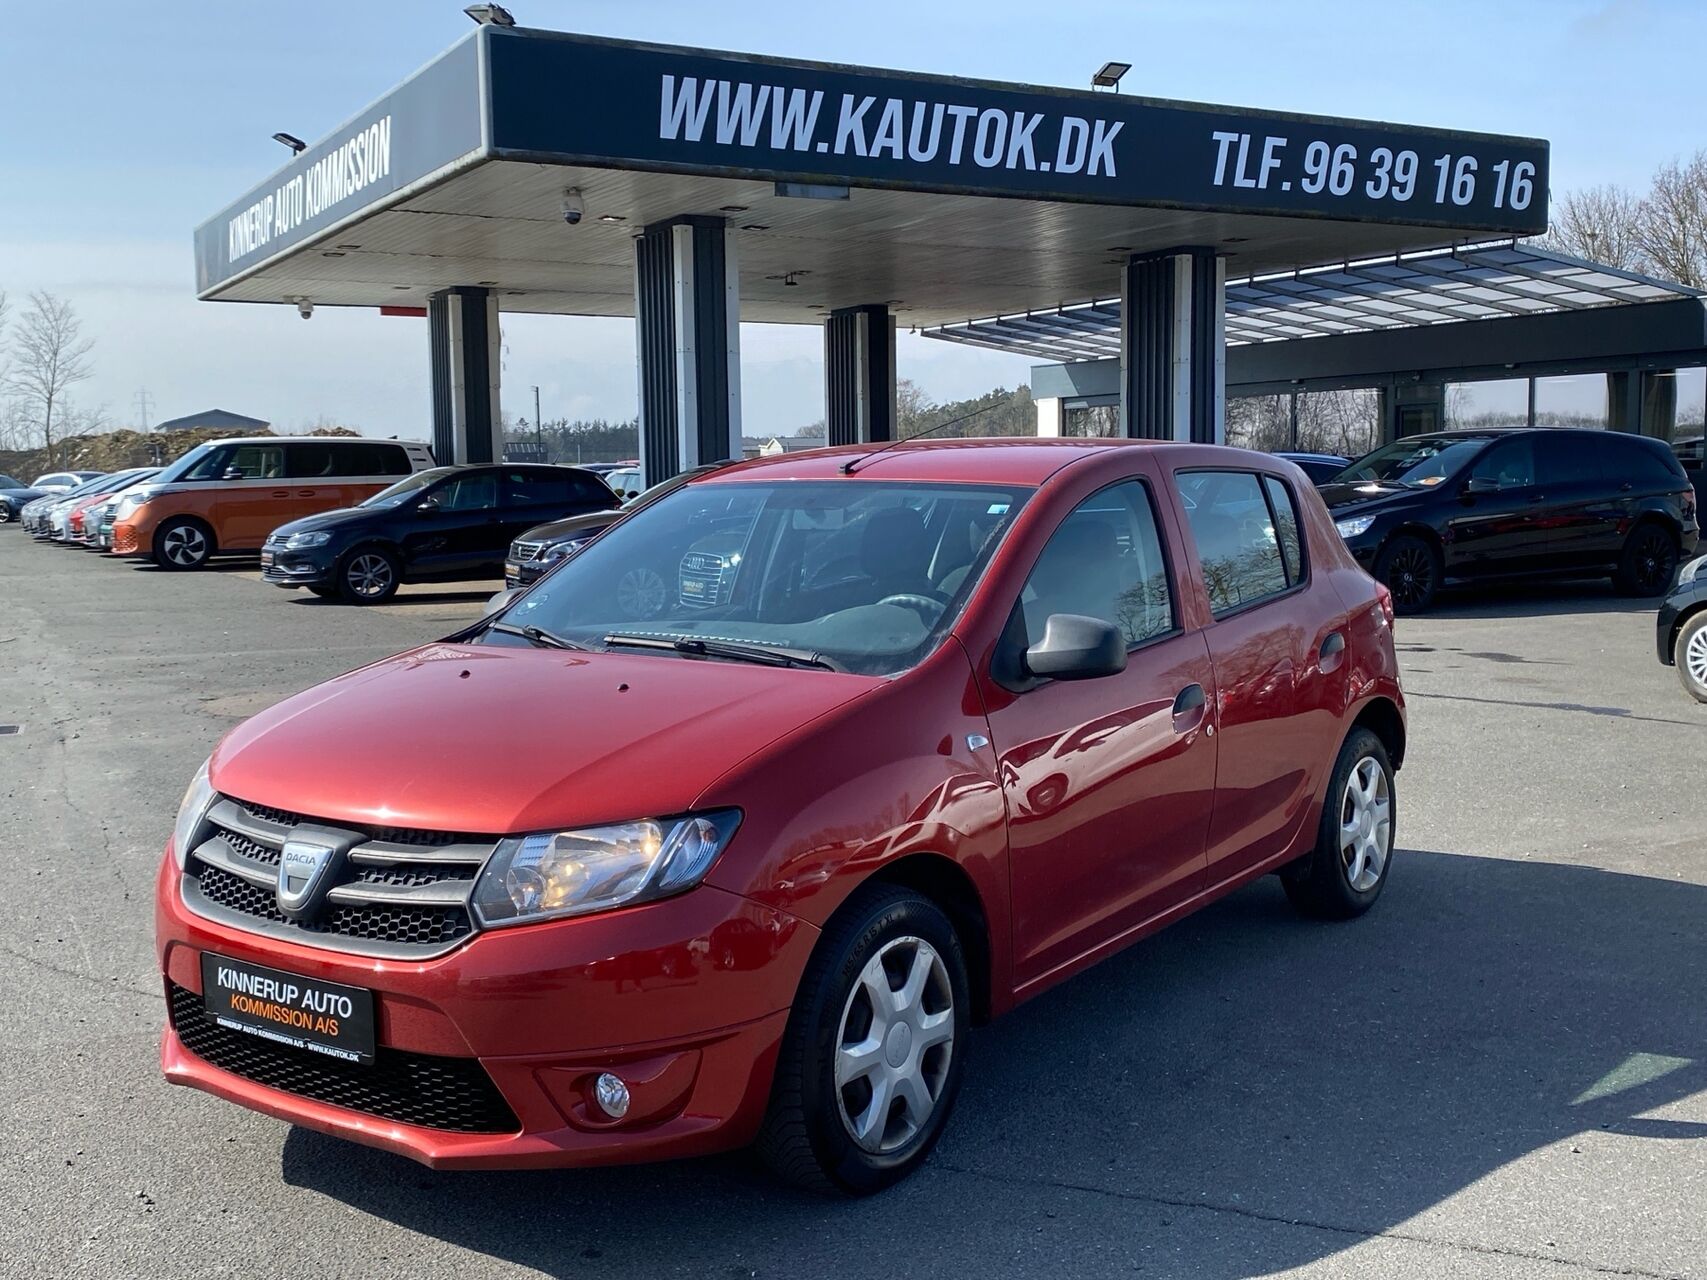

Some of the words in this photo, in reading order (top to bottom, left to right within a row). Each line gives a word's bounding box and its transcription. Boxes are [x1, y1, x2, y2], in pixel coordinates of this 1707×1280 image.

[659, 74, 1126, 178] WWW.KAUTOK.DK
[229, 194, 274, 264] KINNERUP
[274, 174, 303, 238] AUTO
[305, 114, 392, 221] KOMMISSION
[1212, 130, 1292, 192] TLF.
[1301, 140, 1358, 197] 96
[1365, 147, 1419, 202] 39
[1433, 154, 1479, 207] 16
[1492, 159, 1537, 211] 16
[285, 852, 317, 866] DACIA
[217, 966, 299, 1005] KINNERUP
[301, 988, 353, 1019] AUTO
[230, 993, 314, 1030] KOMMISSION
[314, 1013, 340, 1037] A/S
[216, 1017, 243, 1032] KINNERUP
[242, 1023, 259, 1036] AUTO
[257, 1028, 294, 1047] KOMMISSION
[293, 1038, 305, 1049] A/S
[307, 1042, 360, 1063] WWW.KAUTOK.DK
